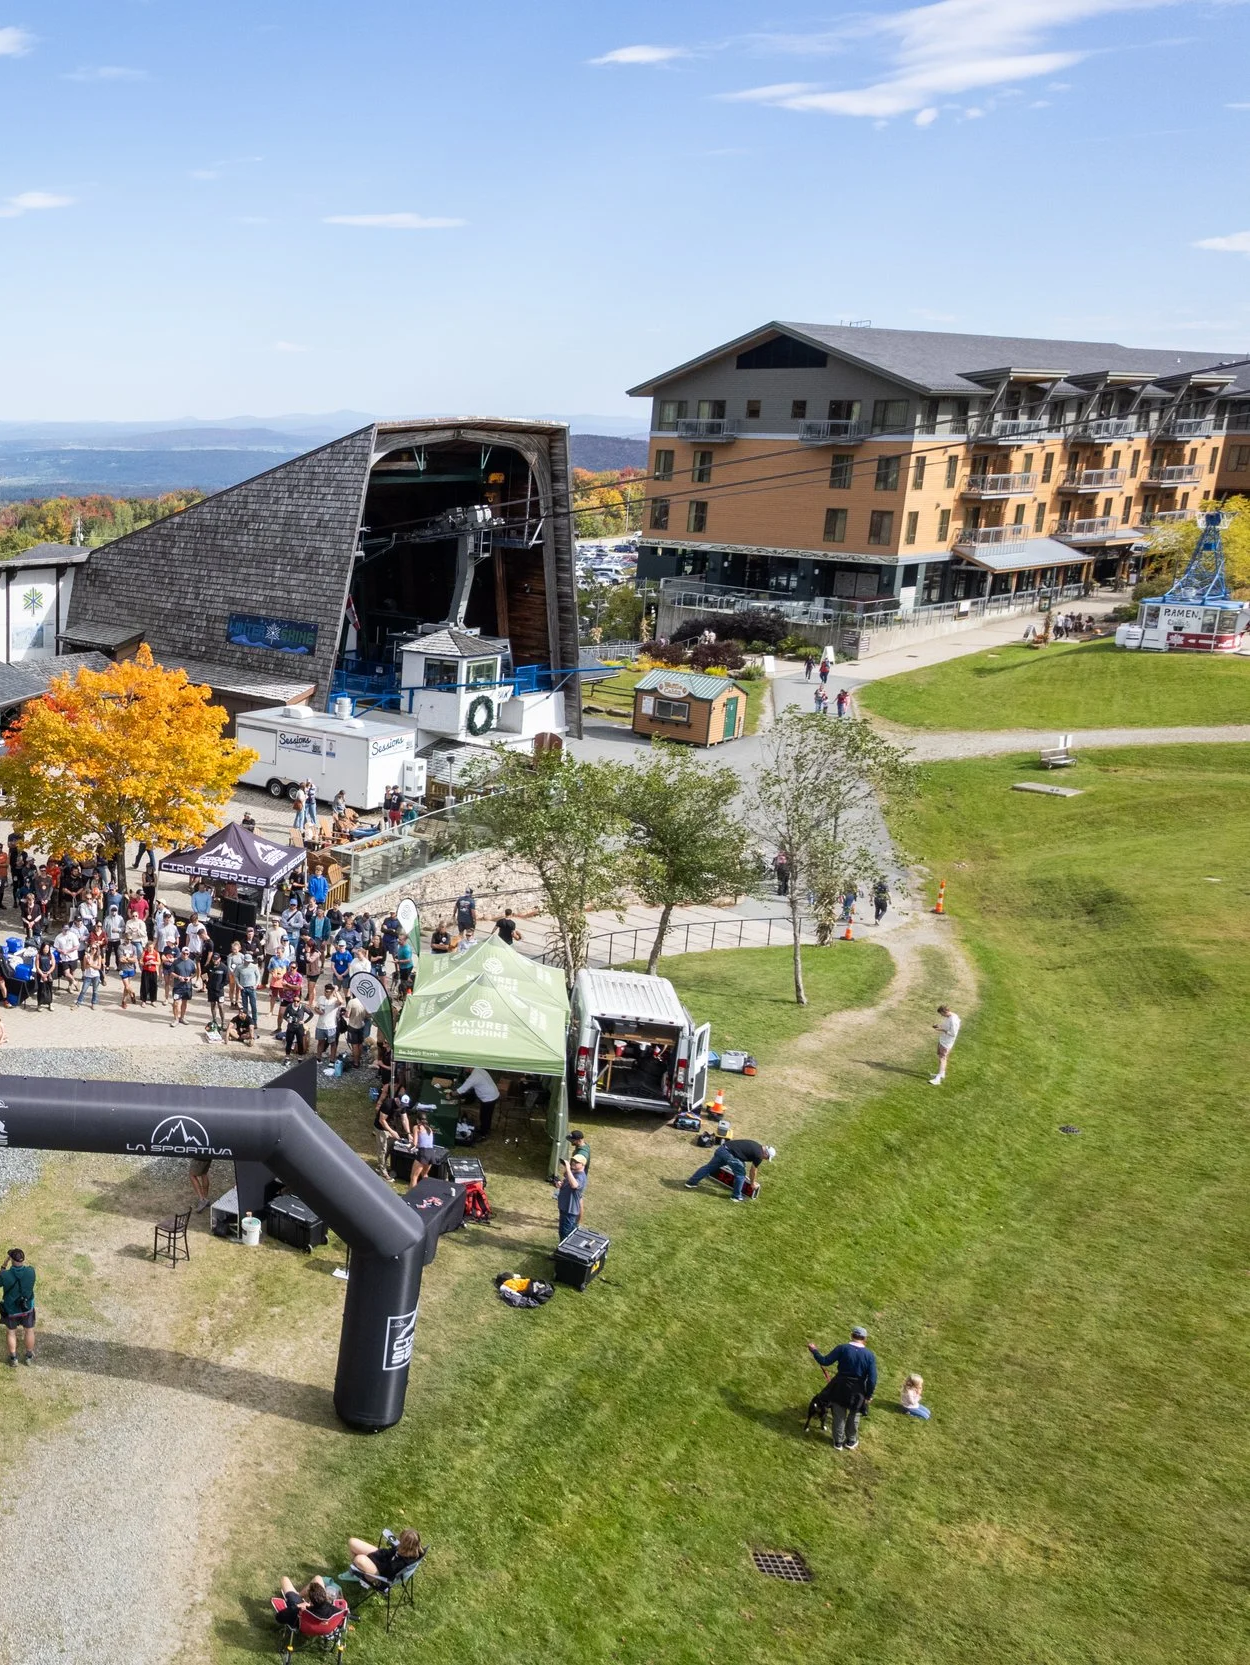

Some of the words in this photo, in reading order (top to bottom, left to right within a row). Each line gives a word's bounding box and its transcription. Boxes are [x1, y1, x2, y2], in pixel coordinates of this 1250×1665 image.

[281, 629, 315, 645] SHINE
[279, 733, 311, 745] Sessions
[371, 736, 405, 756] Sessions
[161, 862, 209, 876] CIRQUE
[209, 869, 267, 887] SERIES
[451, 1027, 509, 1039] SUNSHINE
[126, 1143, 146, 1151] LA
[150, 1144, 232, 1156] SPORTIVA
